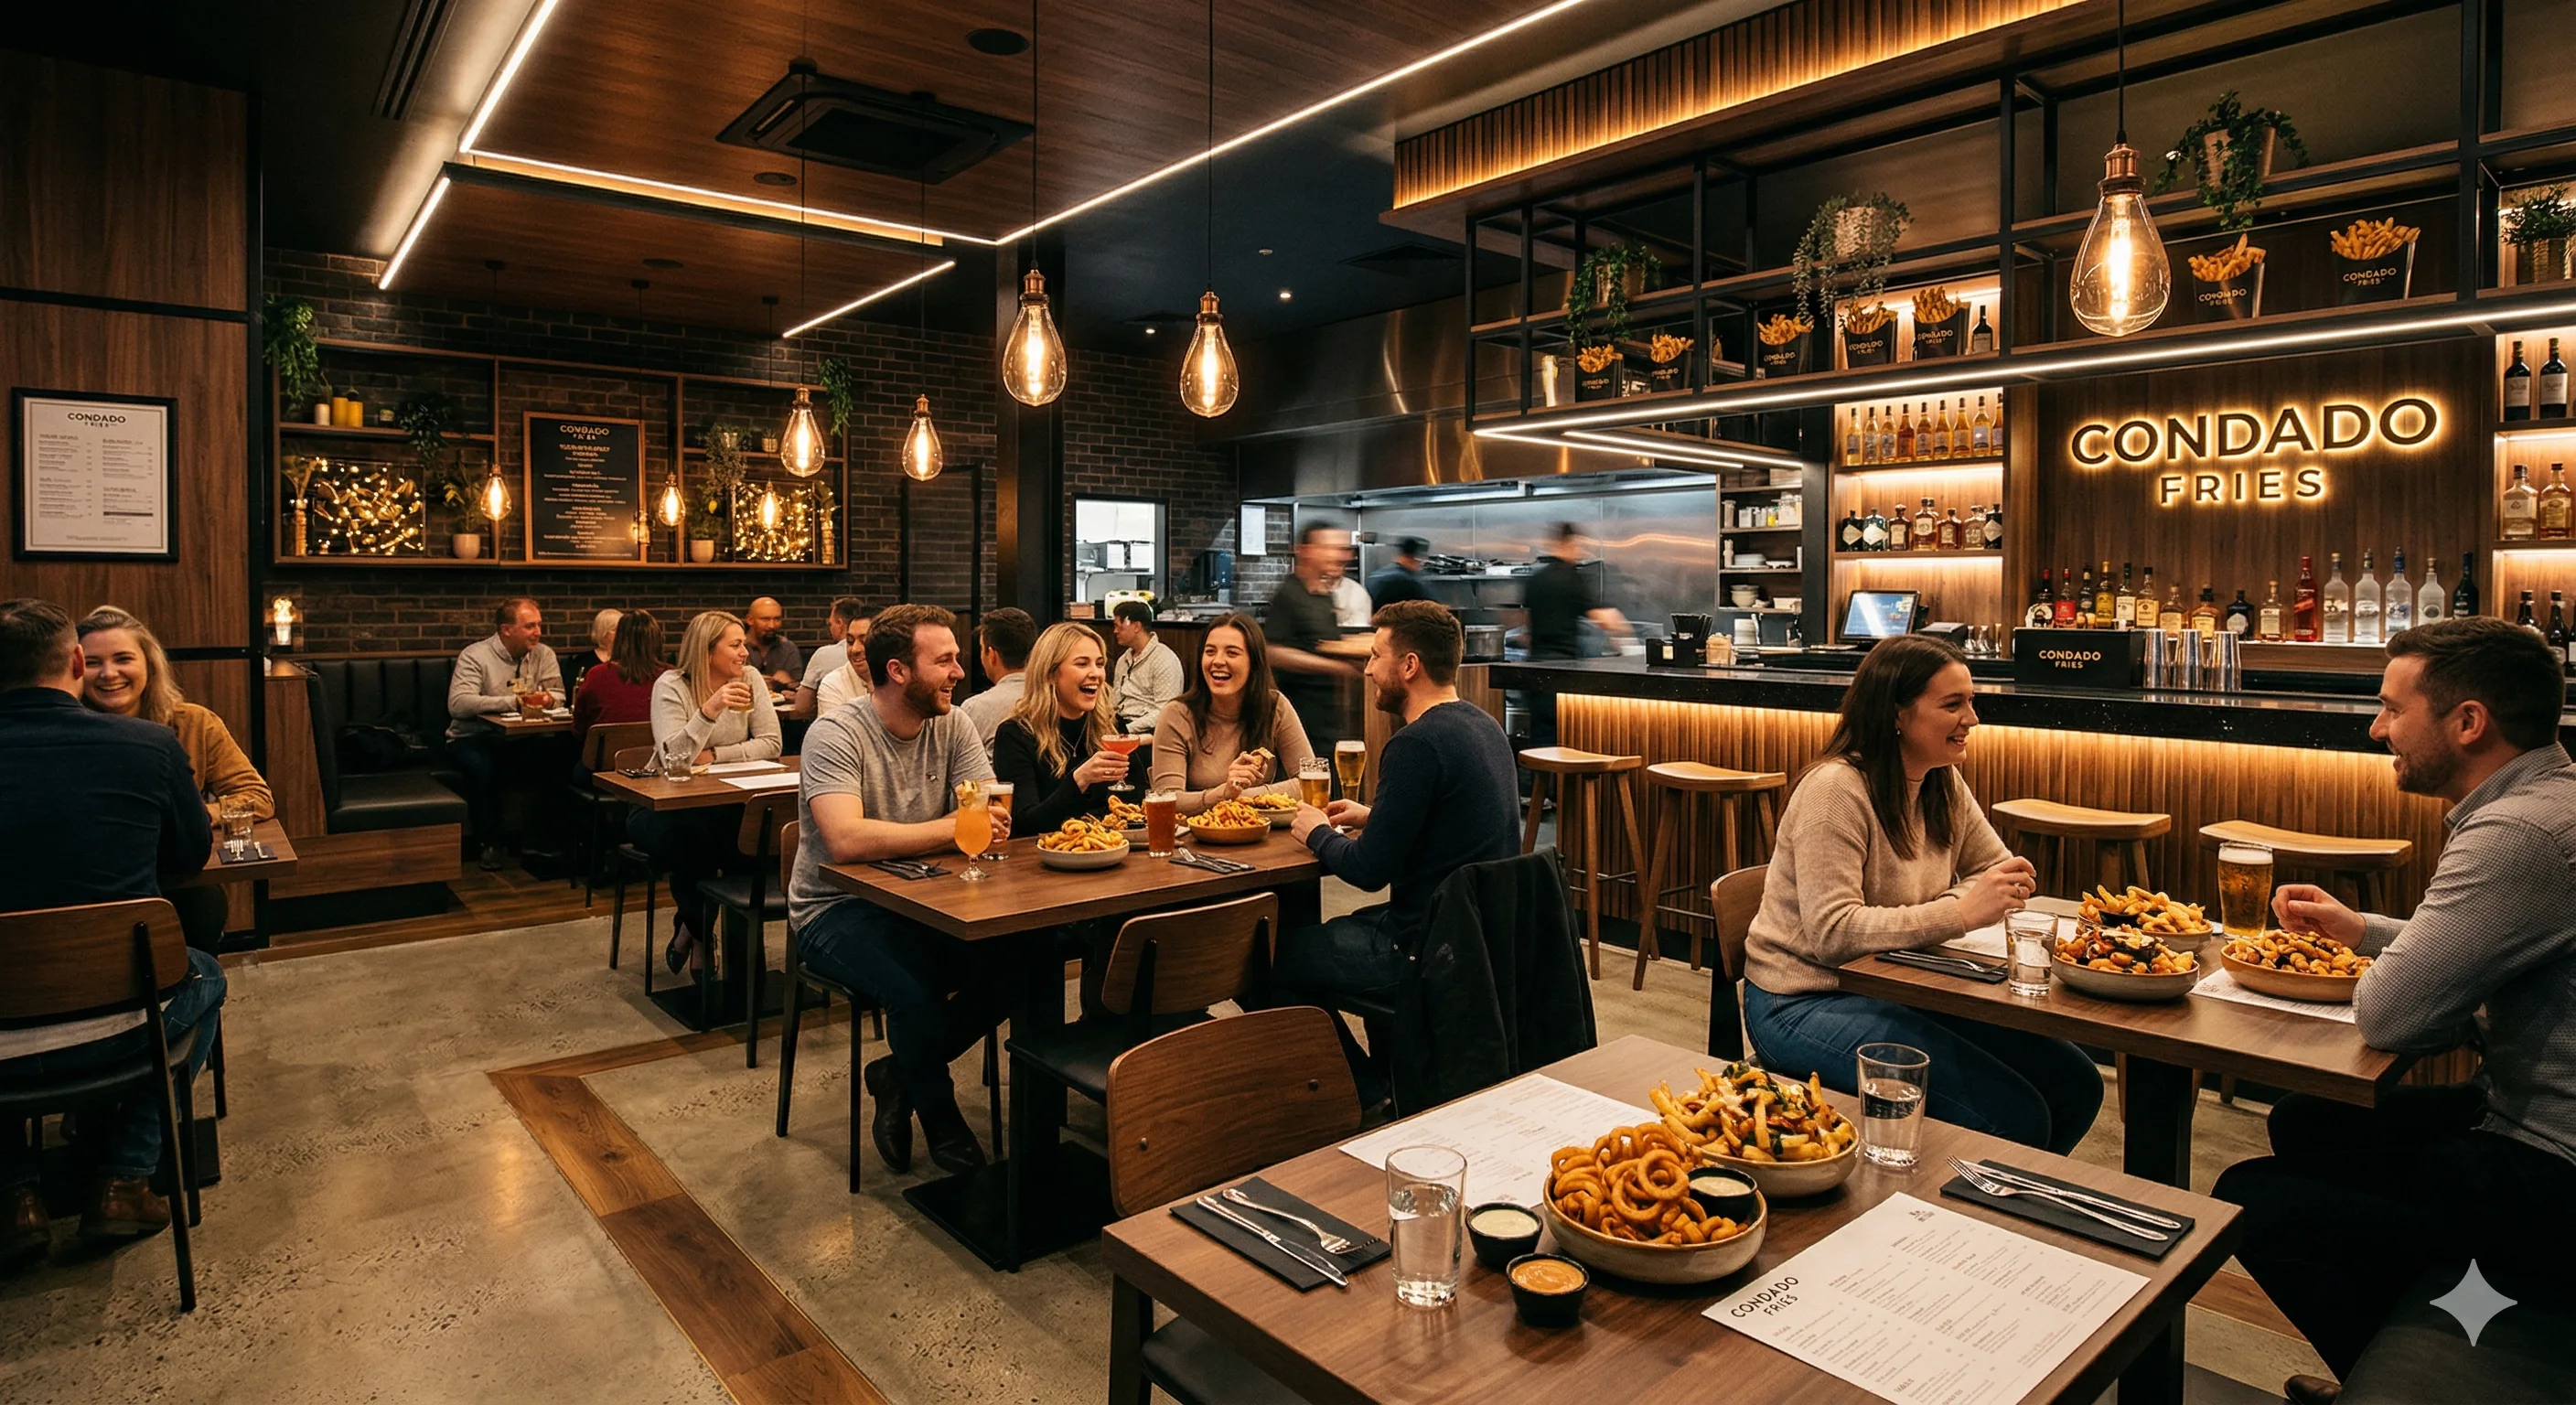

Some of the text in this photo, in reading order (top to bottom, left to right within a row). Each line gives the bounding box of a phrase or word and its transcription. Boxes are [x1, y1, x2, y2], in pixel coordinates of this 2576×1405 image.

[2343, 268, 2397, 282] CONDADO
[67, 413, 126, 424] CONDADO
[2071, 398, 2438, 465] CONDADO
[2160, 469, 2322, 504] FRIES
[2038, 649, 2102, 661] CONDADO
[2055, 660, 2084, 669] FRIES
[1730, 1276, 1799, 1318] CONDADO
[1763, 1293, 1798, 1316] FRIES
